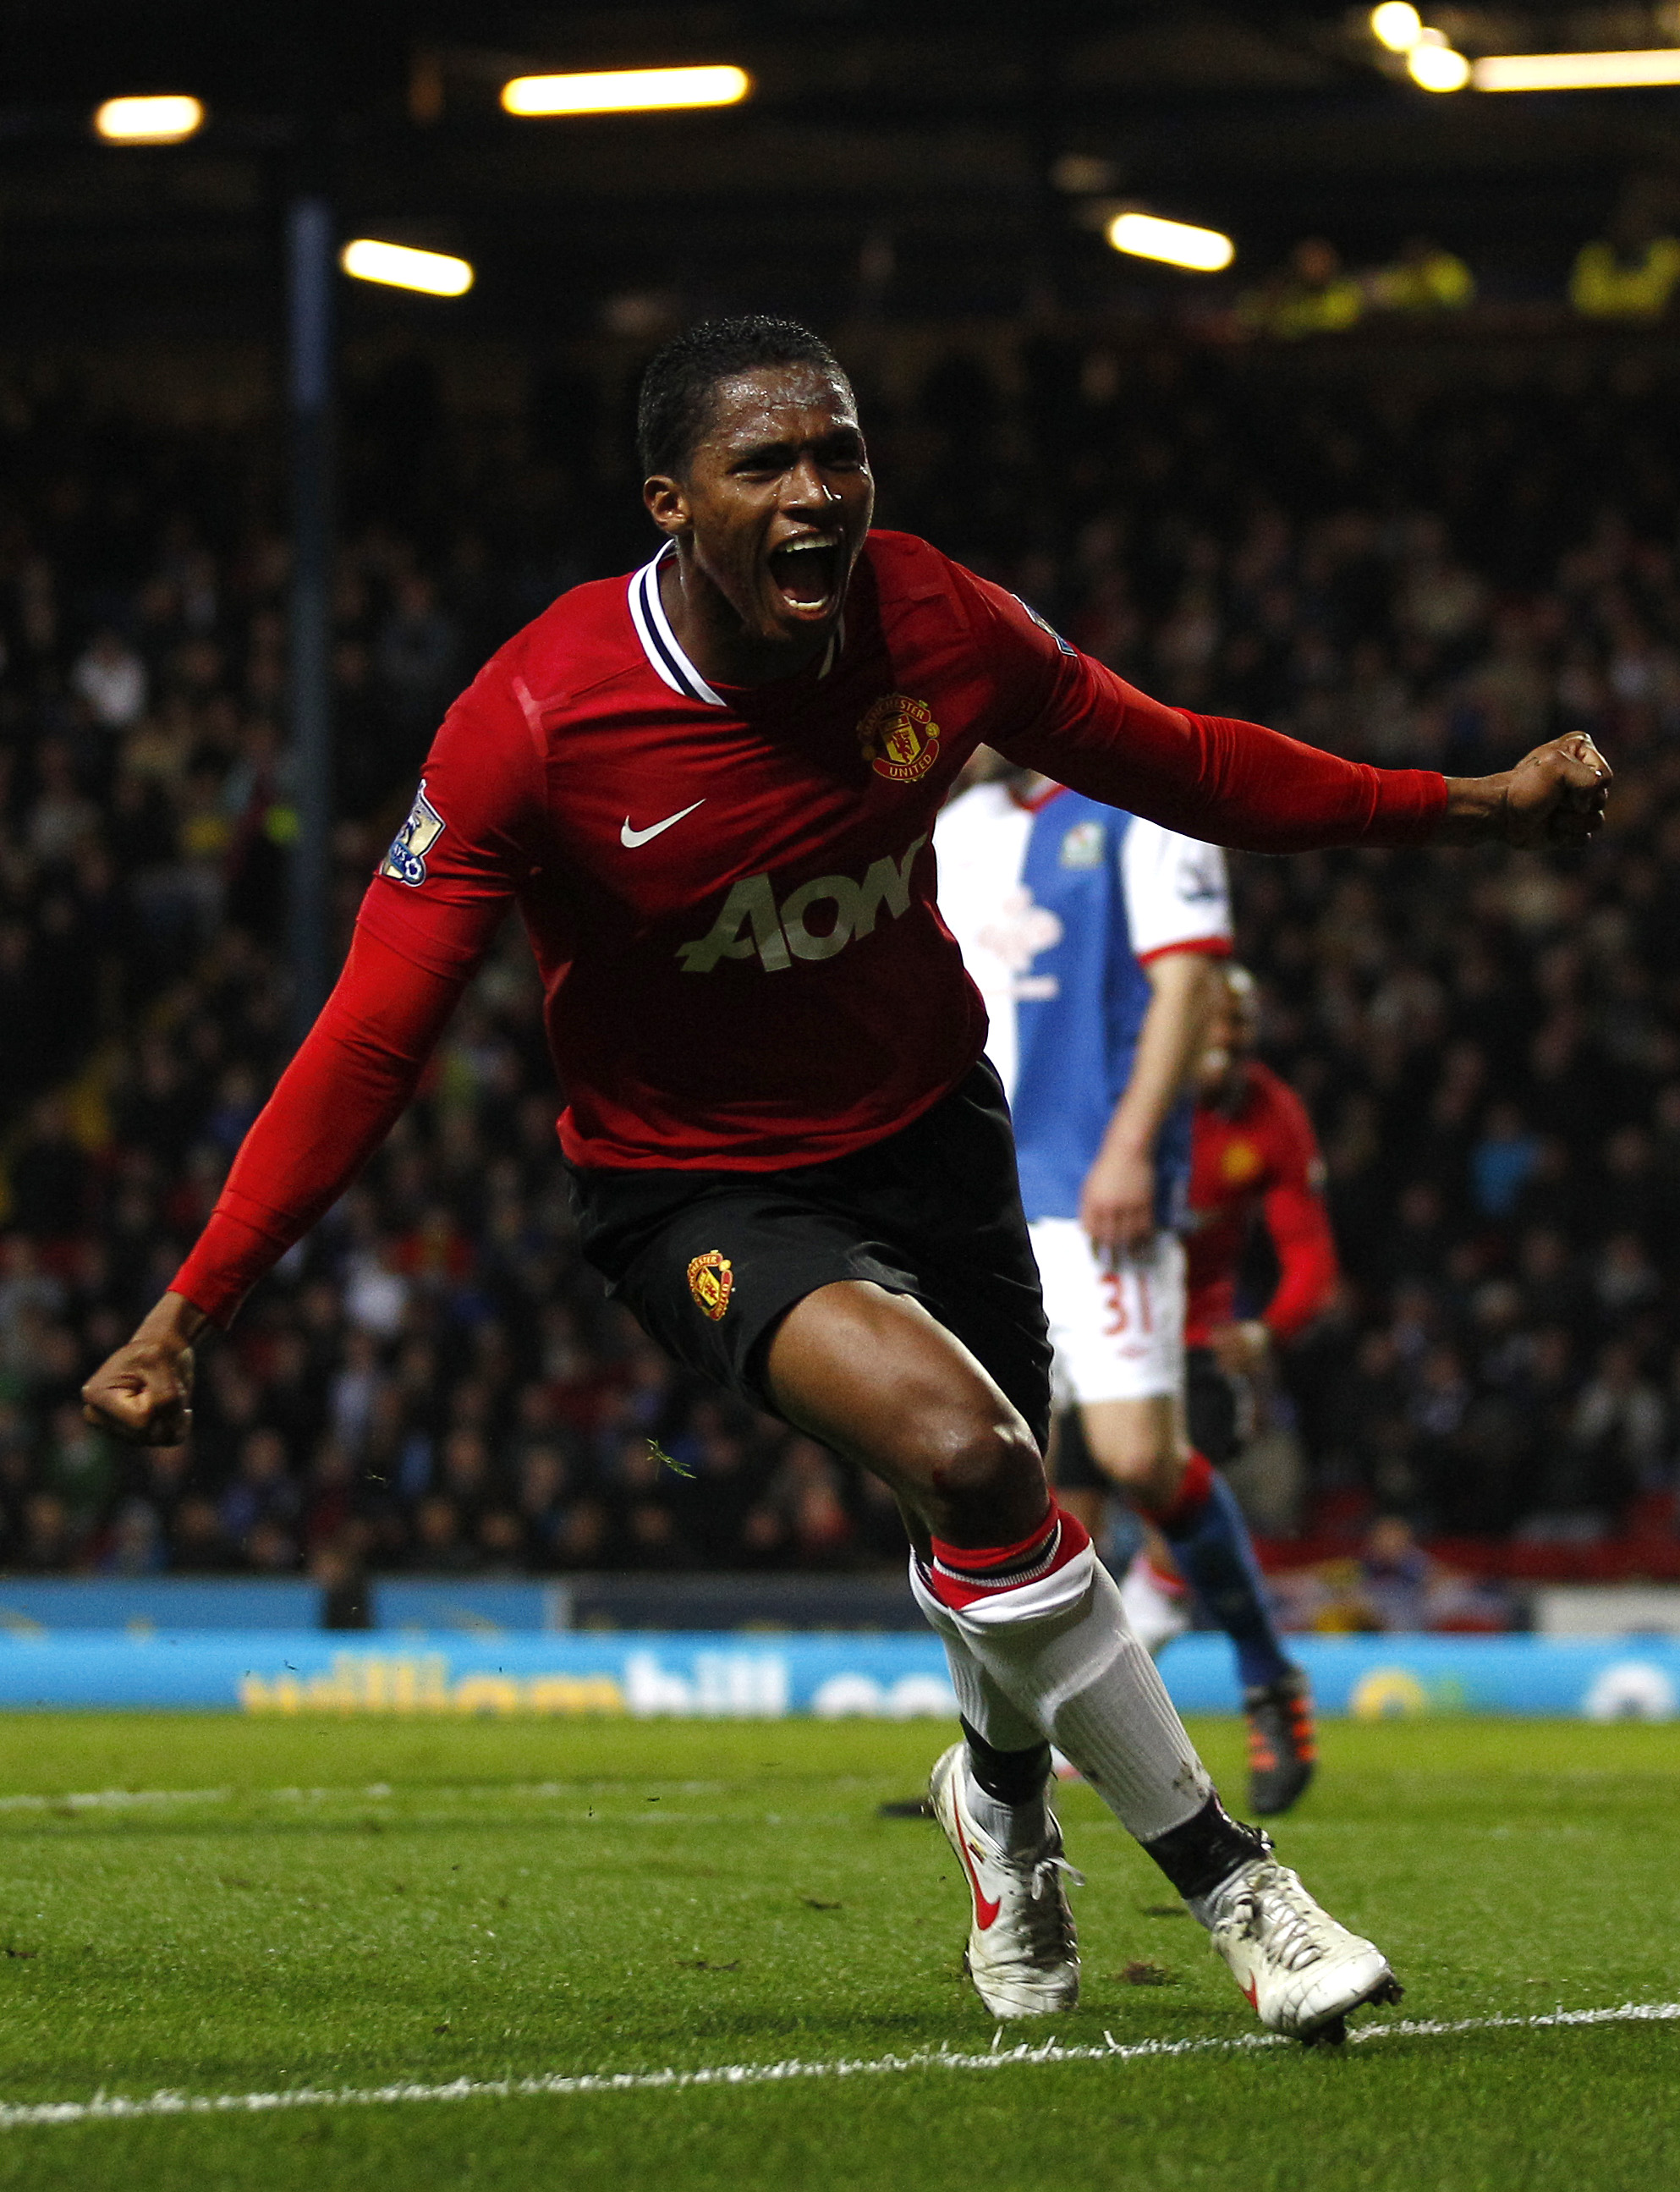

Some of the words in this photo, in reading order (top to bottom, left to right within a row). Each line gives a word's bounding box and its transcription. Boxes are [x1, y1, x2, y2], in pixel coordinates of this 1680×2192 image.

[889, 754, 932, 777] UNITED
[673, 832, 928, 973] AON
[1099, 1272, 1153, 1337] 31
